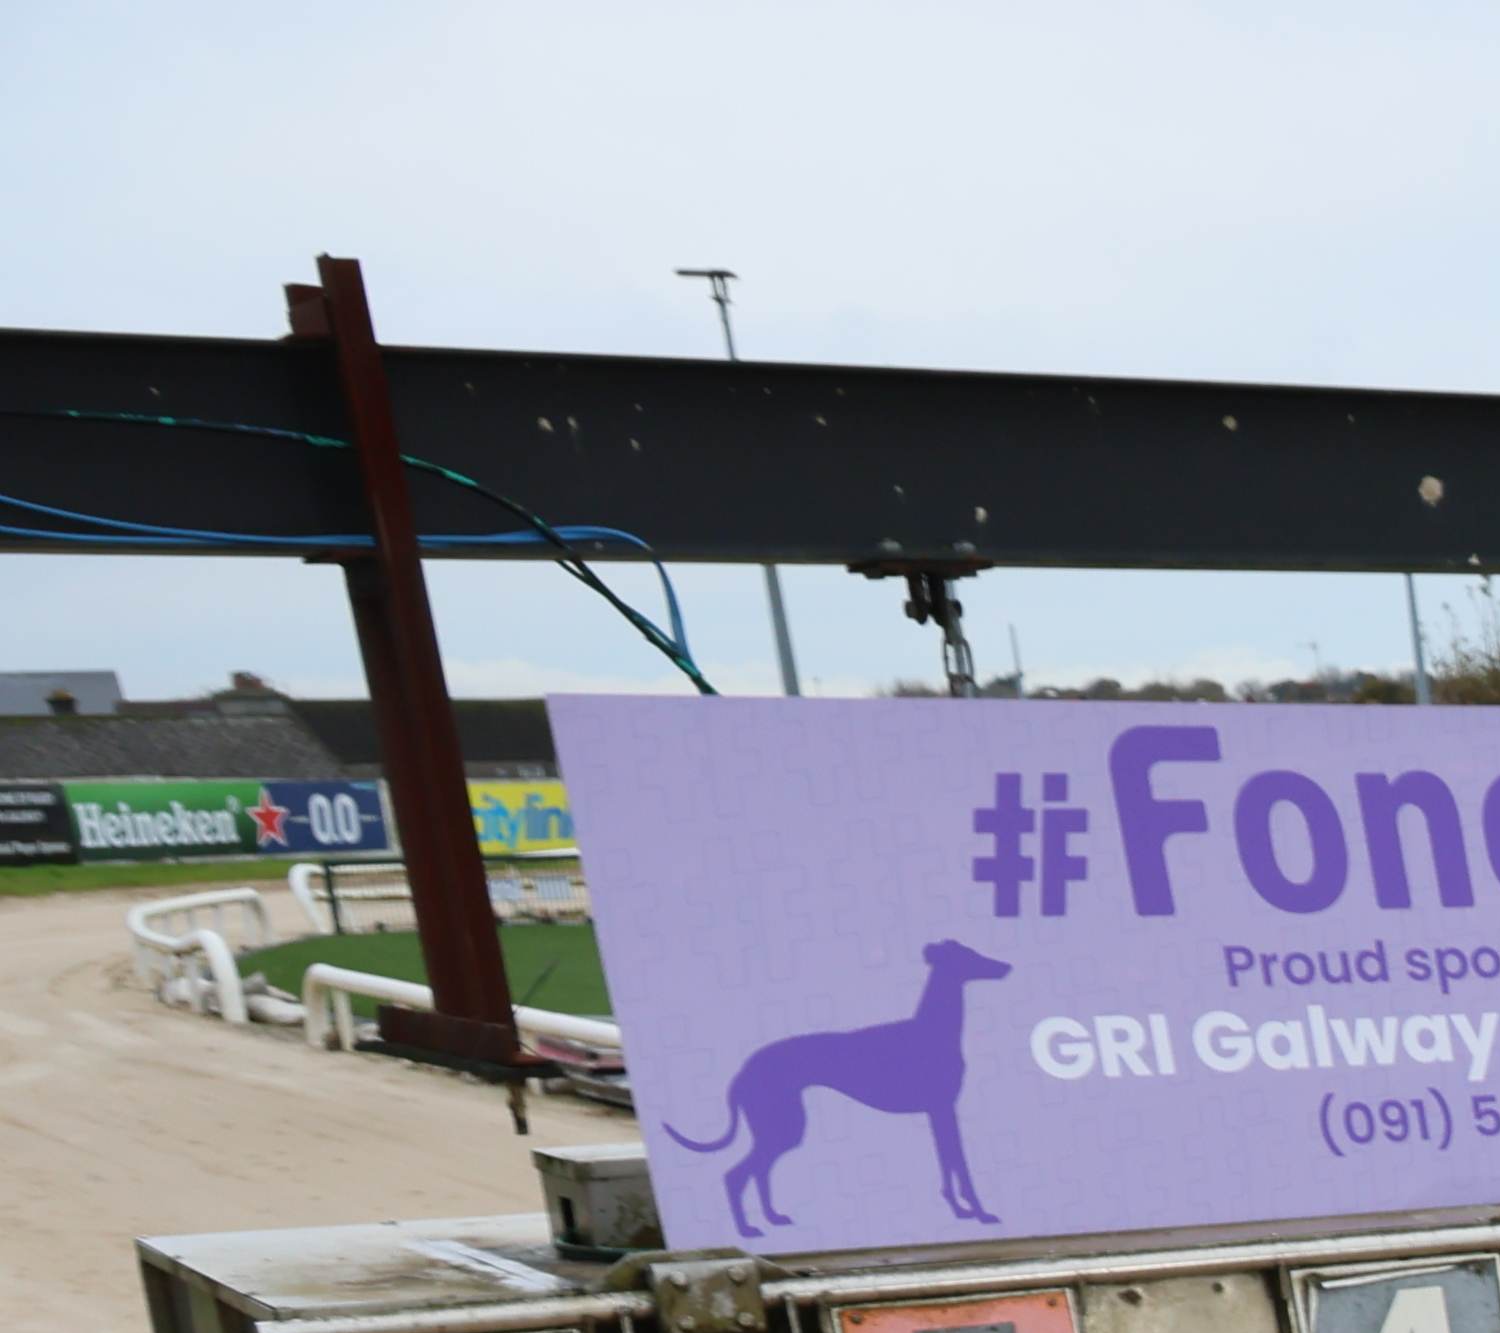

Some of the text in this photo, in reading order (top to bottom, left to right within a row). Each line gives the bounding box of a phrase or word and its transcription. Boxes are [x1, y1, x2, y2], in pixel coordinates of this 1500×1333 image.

[72, 801, 241, 849] Heineken
[1222, 938, 1391, 990] Proud
[1030, 1007, 1177, 1081] GRI
[1193, 998, 1498, 1082] Galway
[1318, 1087, 1455, 1156] (091)
